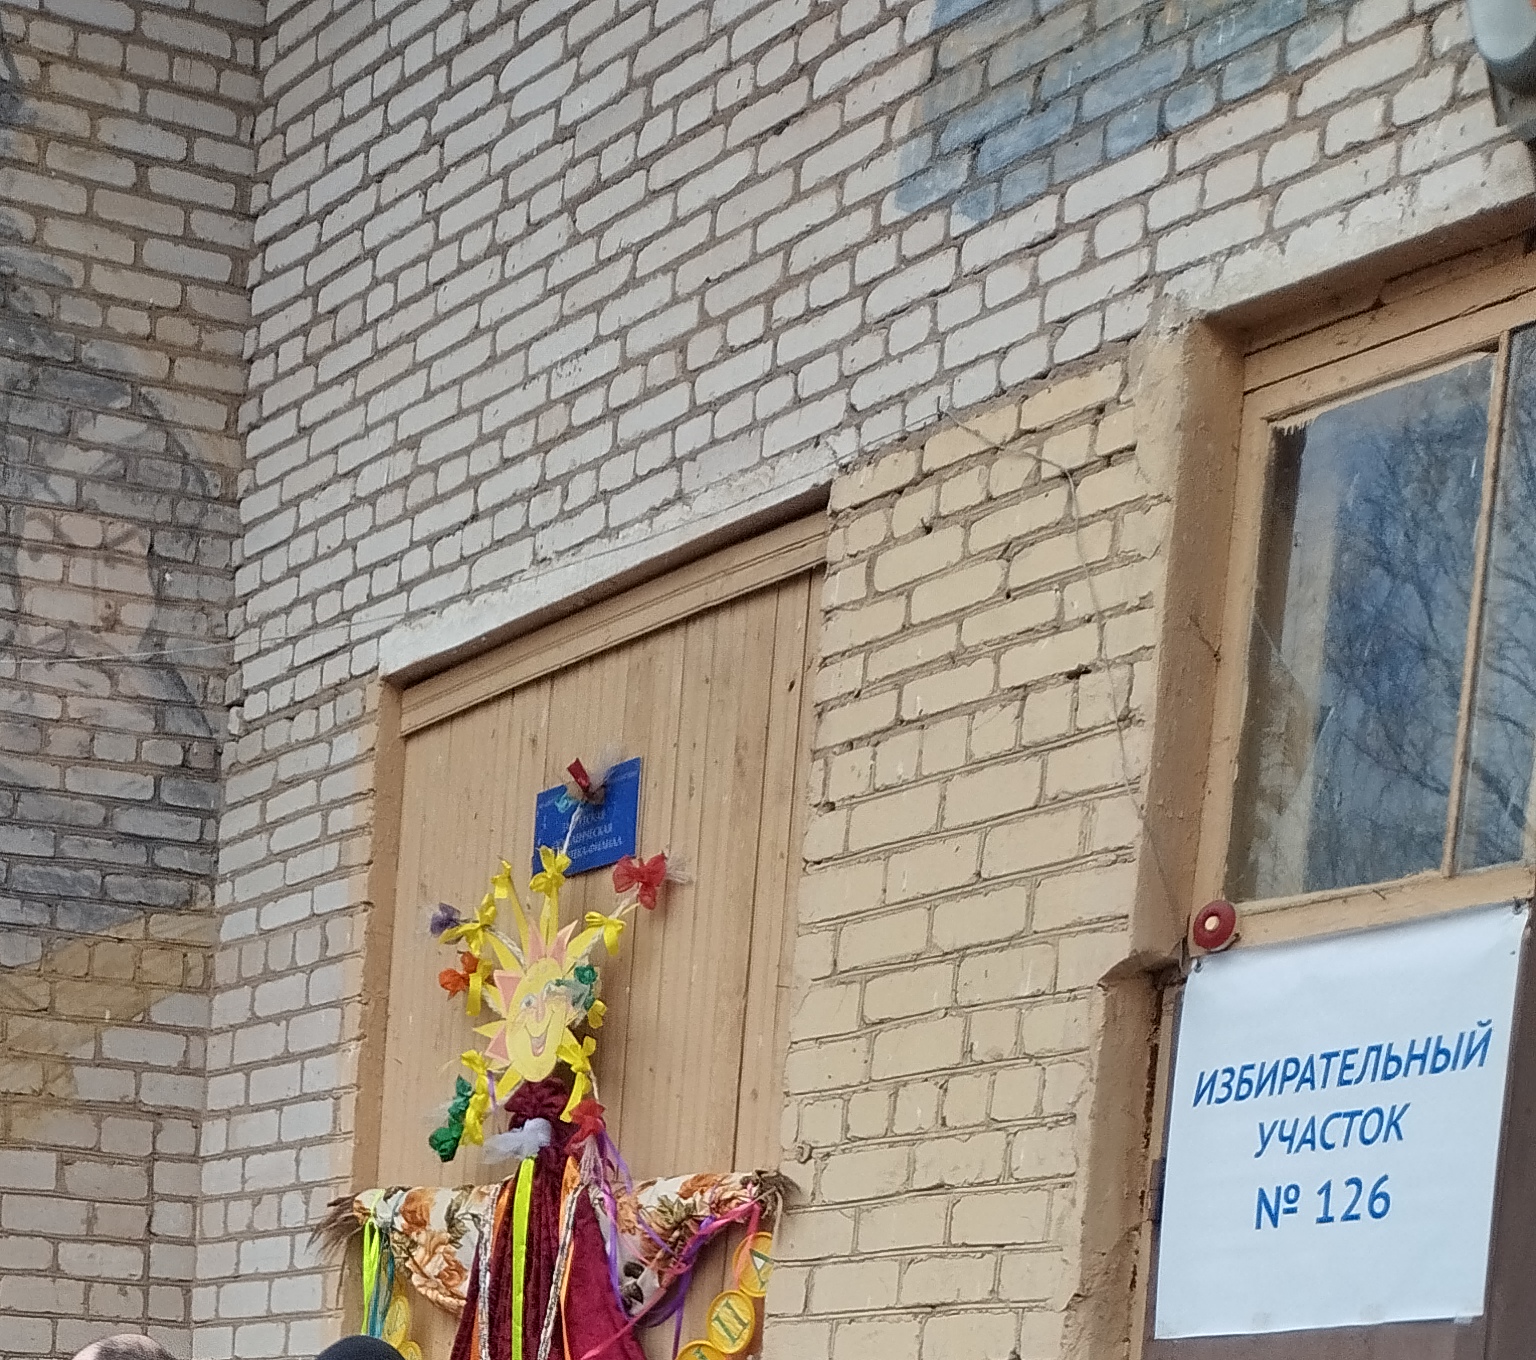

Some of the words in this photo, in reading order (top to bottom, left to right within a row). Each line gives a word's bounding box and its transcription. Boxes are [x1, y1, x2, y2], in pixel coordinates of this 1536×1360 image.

[1192, 1019, 1494, 1107] ИЗБИРАТЕЛЬНЫЙ
[1253, 1103, 1412, 1158] УЧАСТОК
[1255, 1184, 1301, 1230] №
[1315, 1174, 1392, 1225] 126
